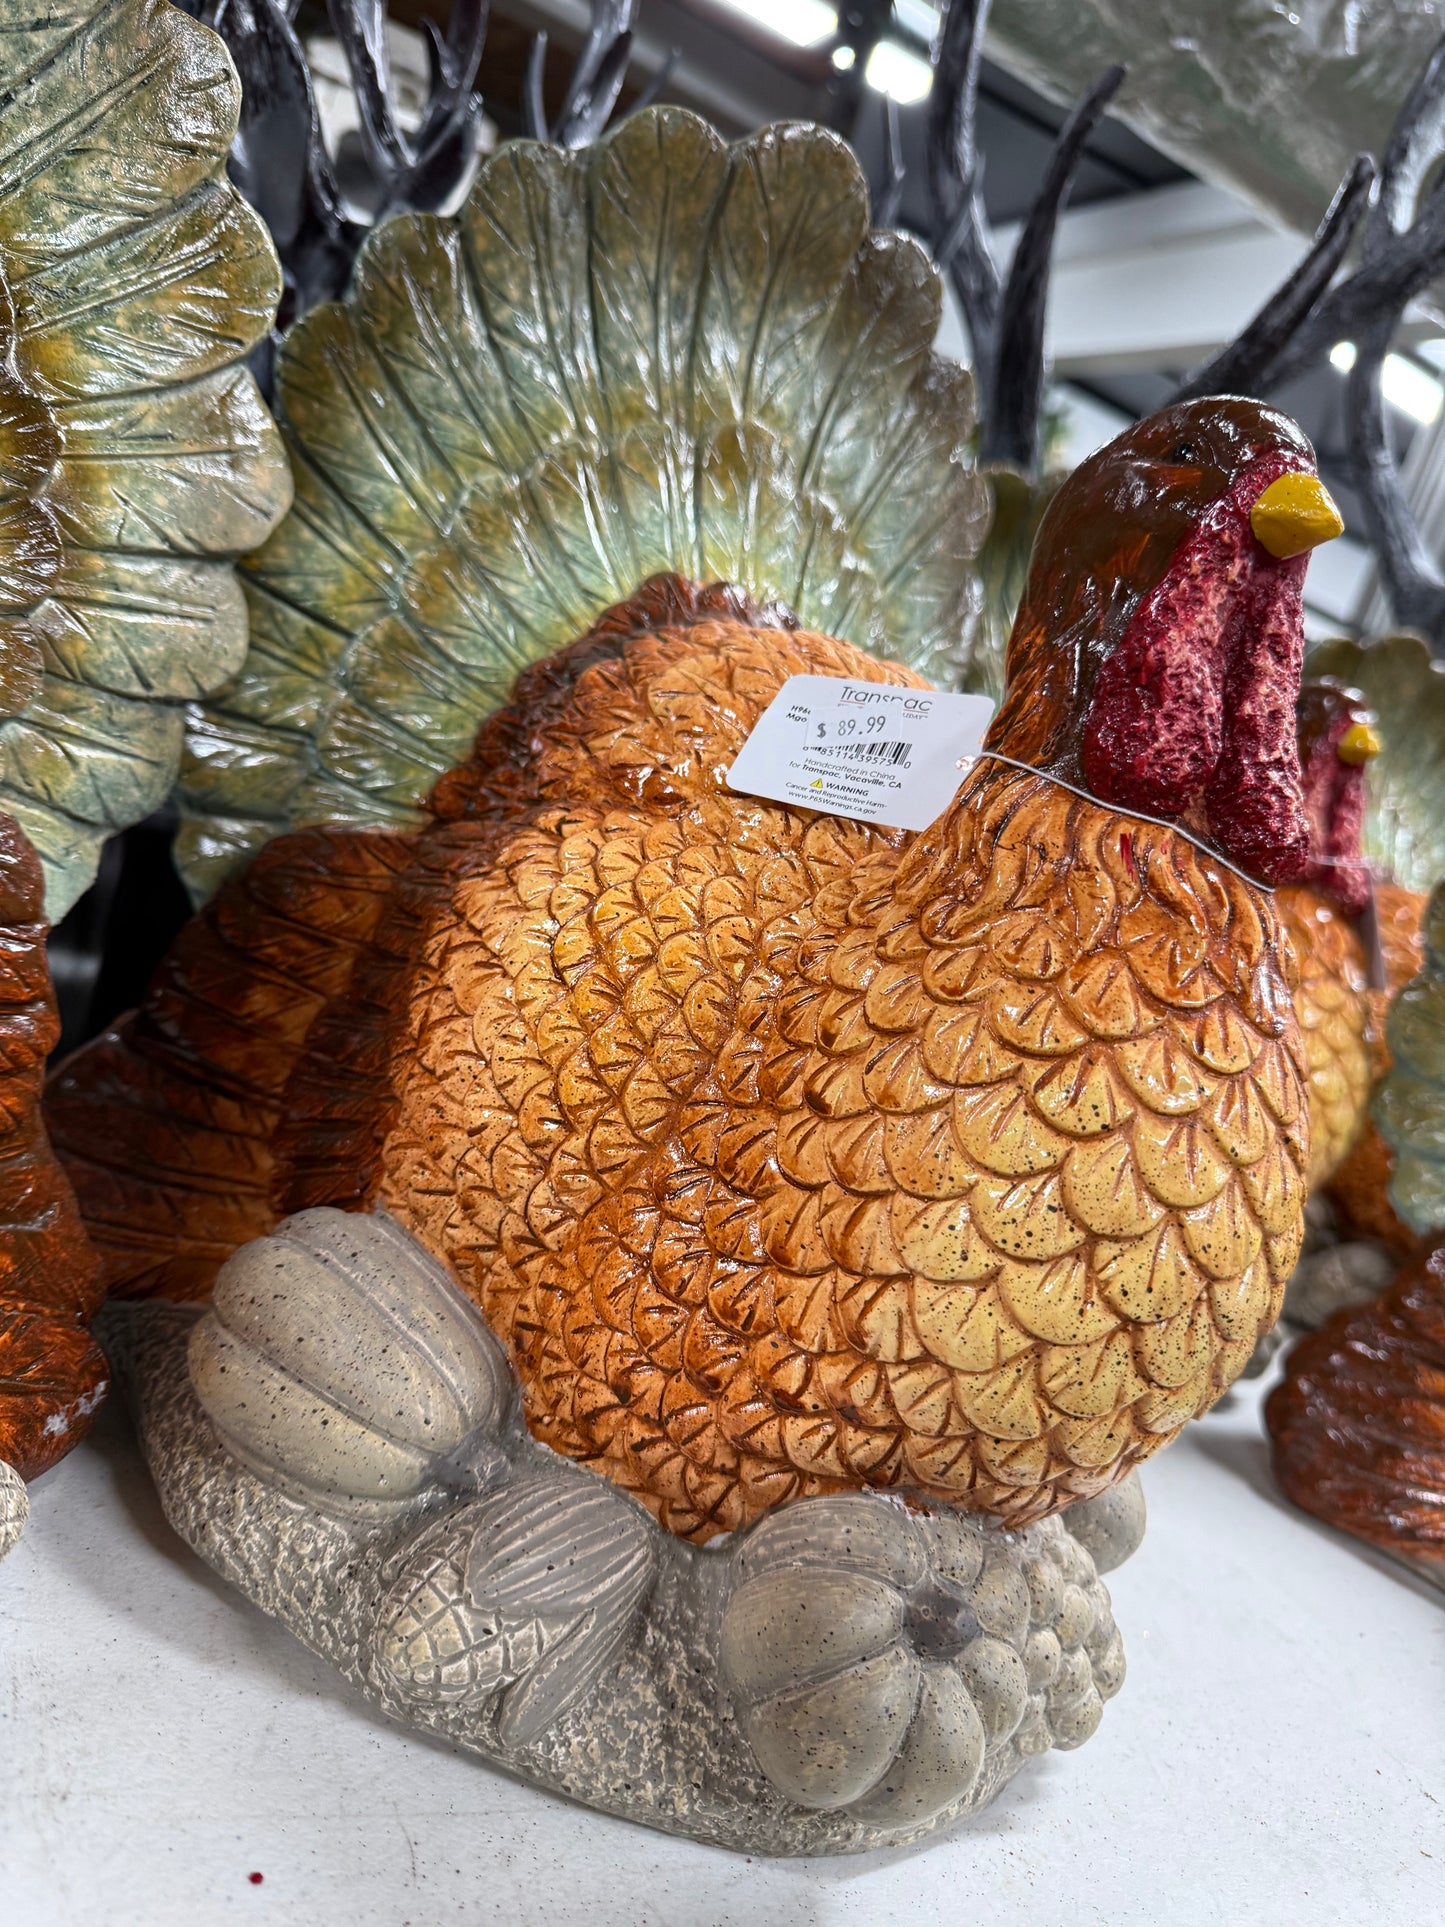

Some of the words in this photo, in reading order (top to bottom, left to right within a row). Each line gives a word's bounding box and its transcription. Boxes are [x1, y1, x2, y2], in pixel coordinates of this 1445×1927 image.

[817, 723, 827, 739] $
[837, 715, 886, 736] 89.99
[789, 760, 801, 769] for
[888, 781, 902, 789] CA
[805, 758, 859, 775] Handcrafted
[869, 771, 896, 781] China
[785, 781, 808, 791] Cancer
[822, 790, 866, 805] Reproductive
[826, 782, 870, 797] WARNING
